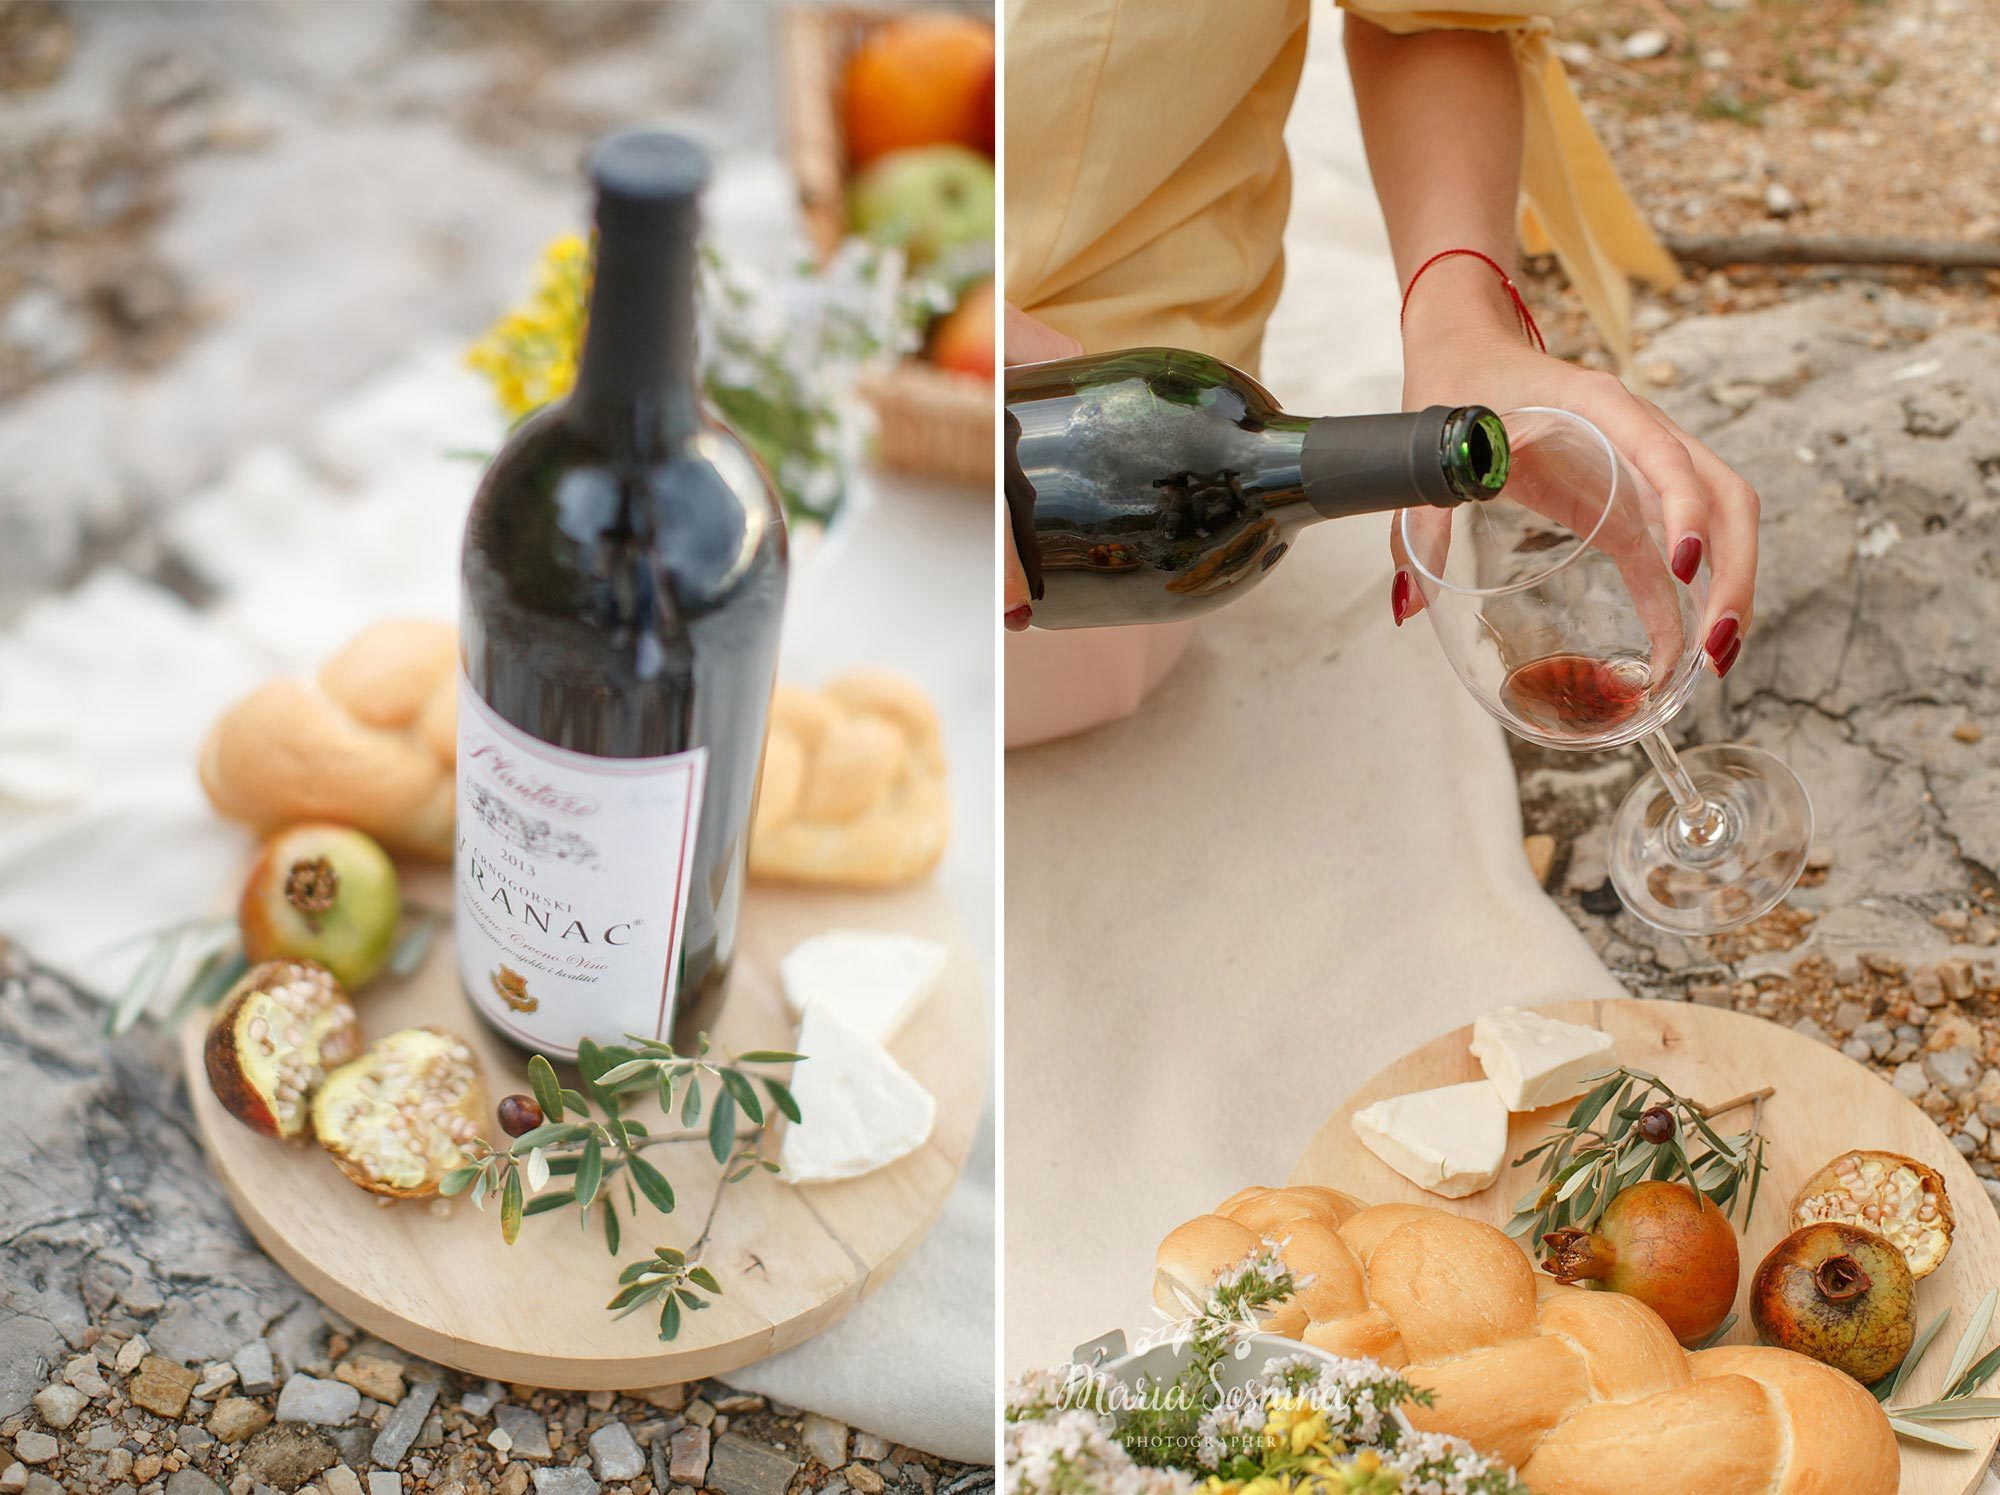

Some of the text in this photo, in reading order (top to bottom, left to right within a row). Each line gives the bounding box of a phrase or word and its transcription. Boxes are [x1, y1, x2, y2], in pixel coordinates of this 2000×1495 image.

[474, 847, 572, 913] CRNOGORSKI
[500, 848, 536, 877] 2013
[507, 927, 560, 961] Crveno
[566, 954, 608, 971] Vino
